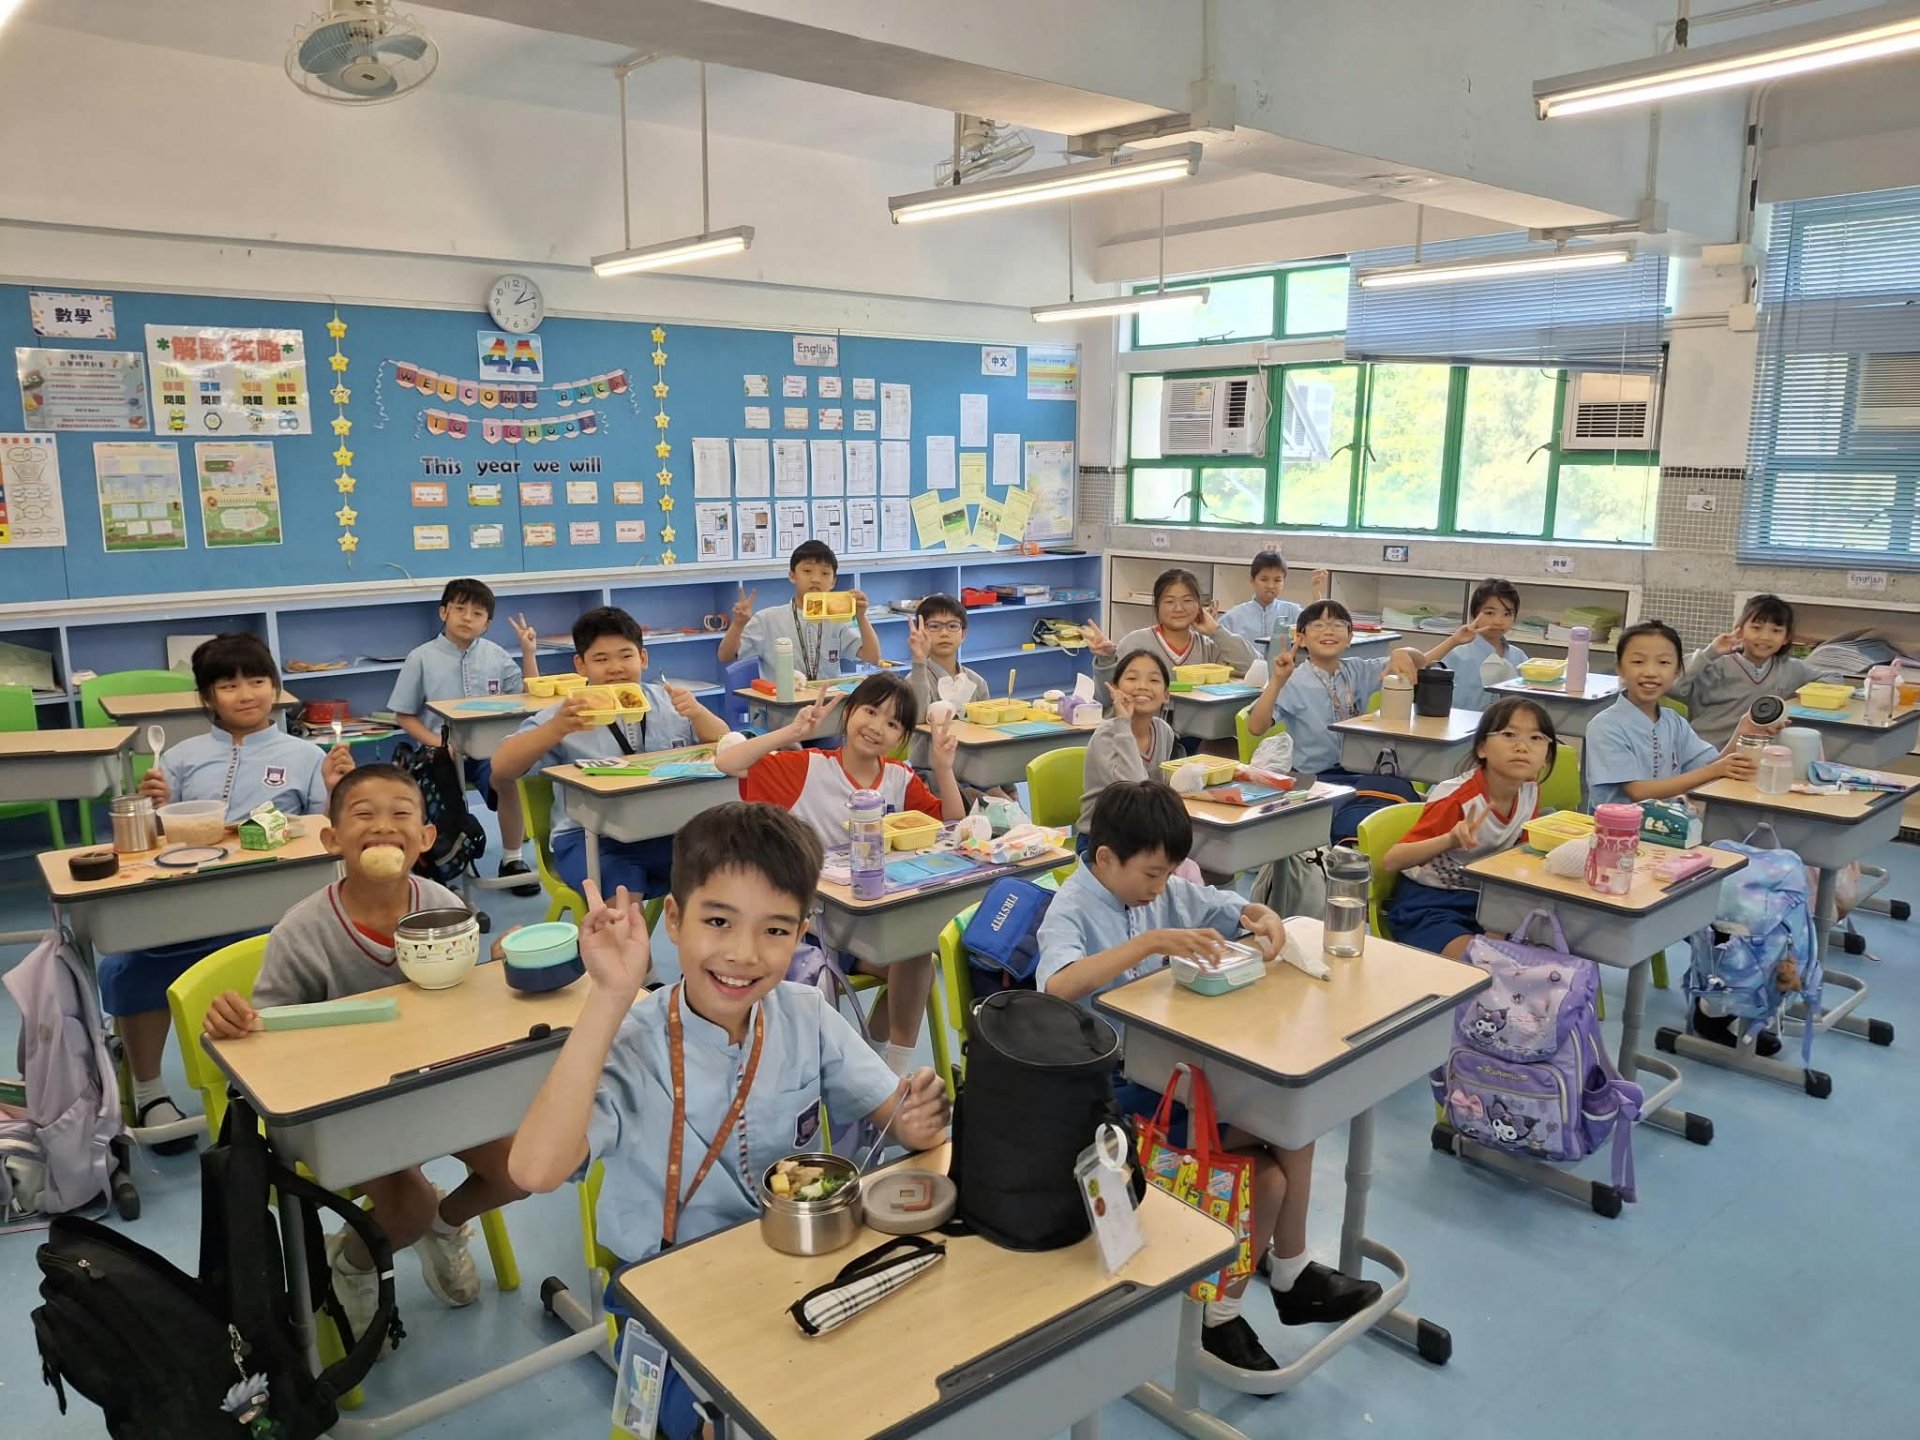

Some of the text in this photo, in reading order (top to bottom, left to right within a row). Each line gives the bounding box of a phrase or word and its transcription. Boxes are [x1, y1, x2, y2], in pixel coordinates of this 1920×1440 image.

[496, 288, 503, 296] 10
[504, 280, 510, 289] 11
[55, 308, 92, 324] 數學
[482, 338, 540, 374] 4A
[797, 342, 834, 356] English
[991, 355, 1007, 367] 中文
[402, 370, 622, 403] WELCOME BACK
[433, 418, 591, 437] TO SCHOOL
[421, 457, 601, 476] This year we will
